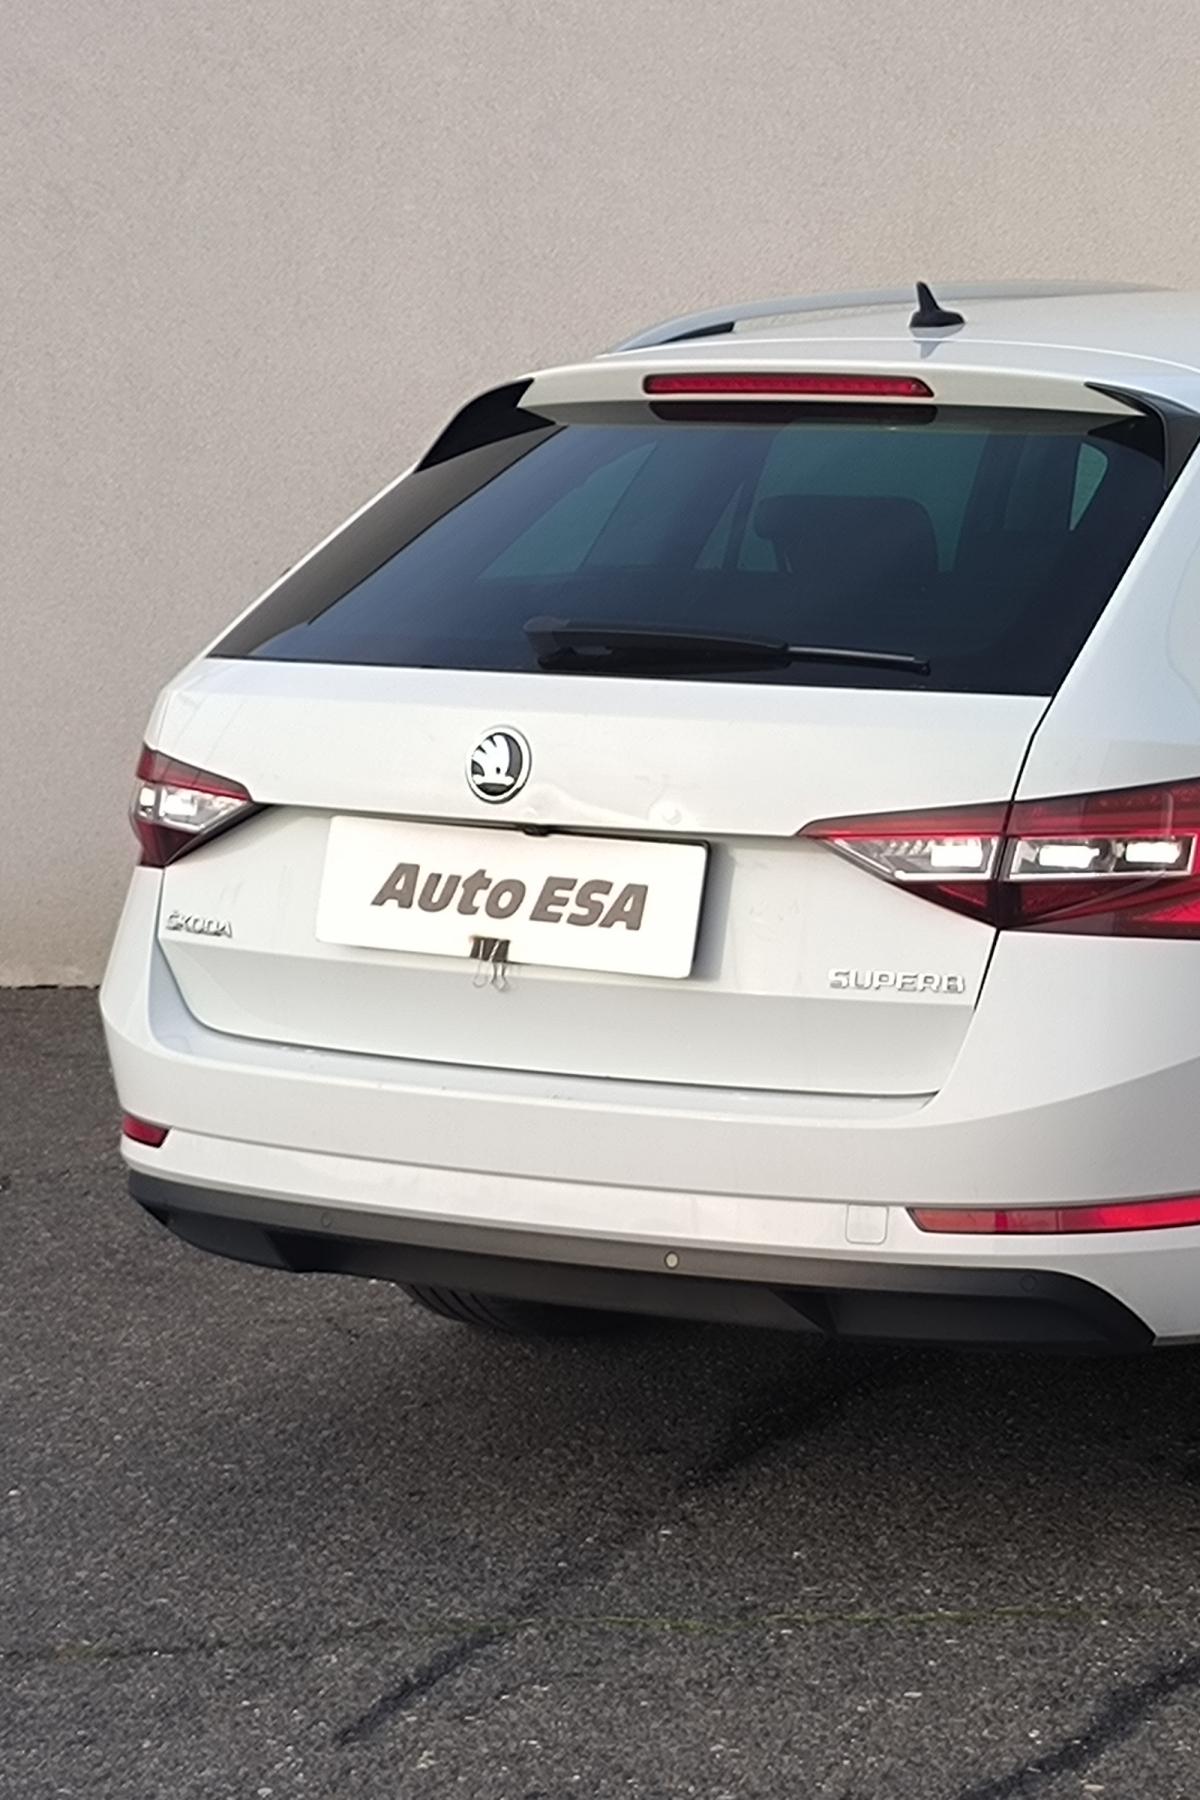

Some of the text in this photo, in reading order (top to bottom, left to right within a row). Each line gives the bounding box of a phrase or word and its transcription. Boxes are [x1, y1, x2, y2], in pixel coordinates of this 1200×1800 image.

[371, 862, 649, 931] Auto ESA
[828, 968, 966, 994] SUPERB
